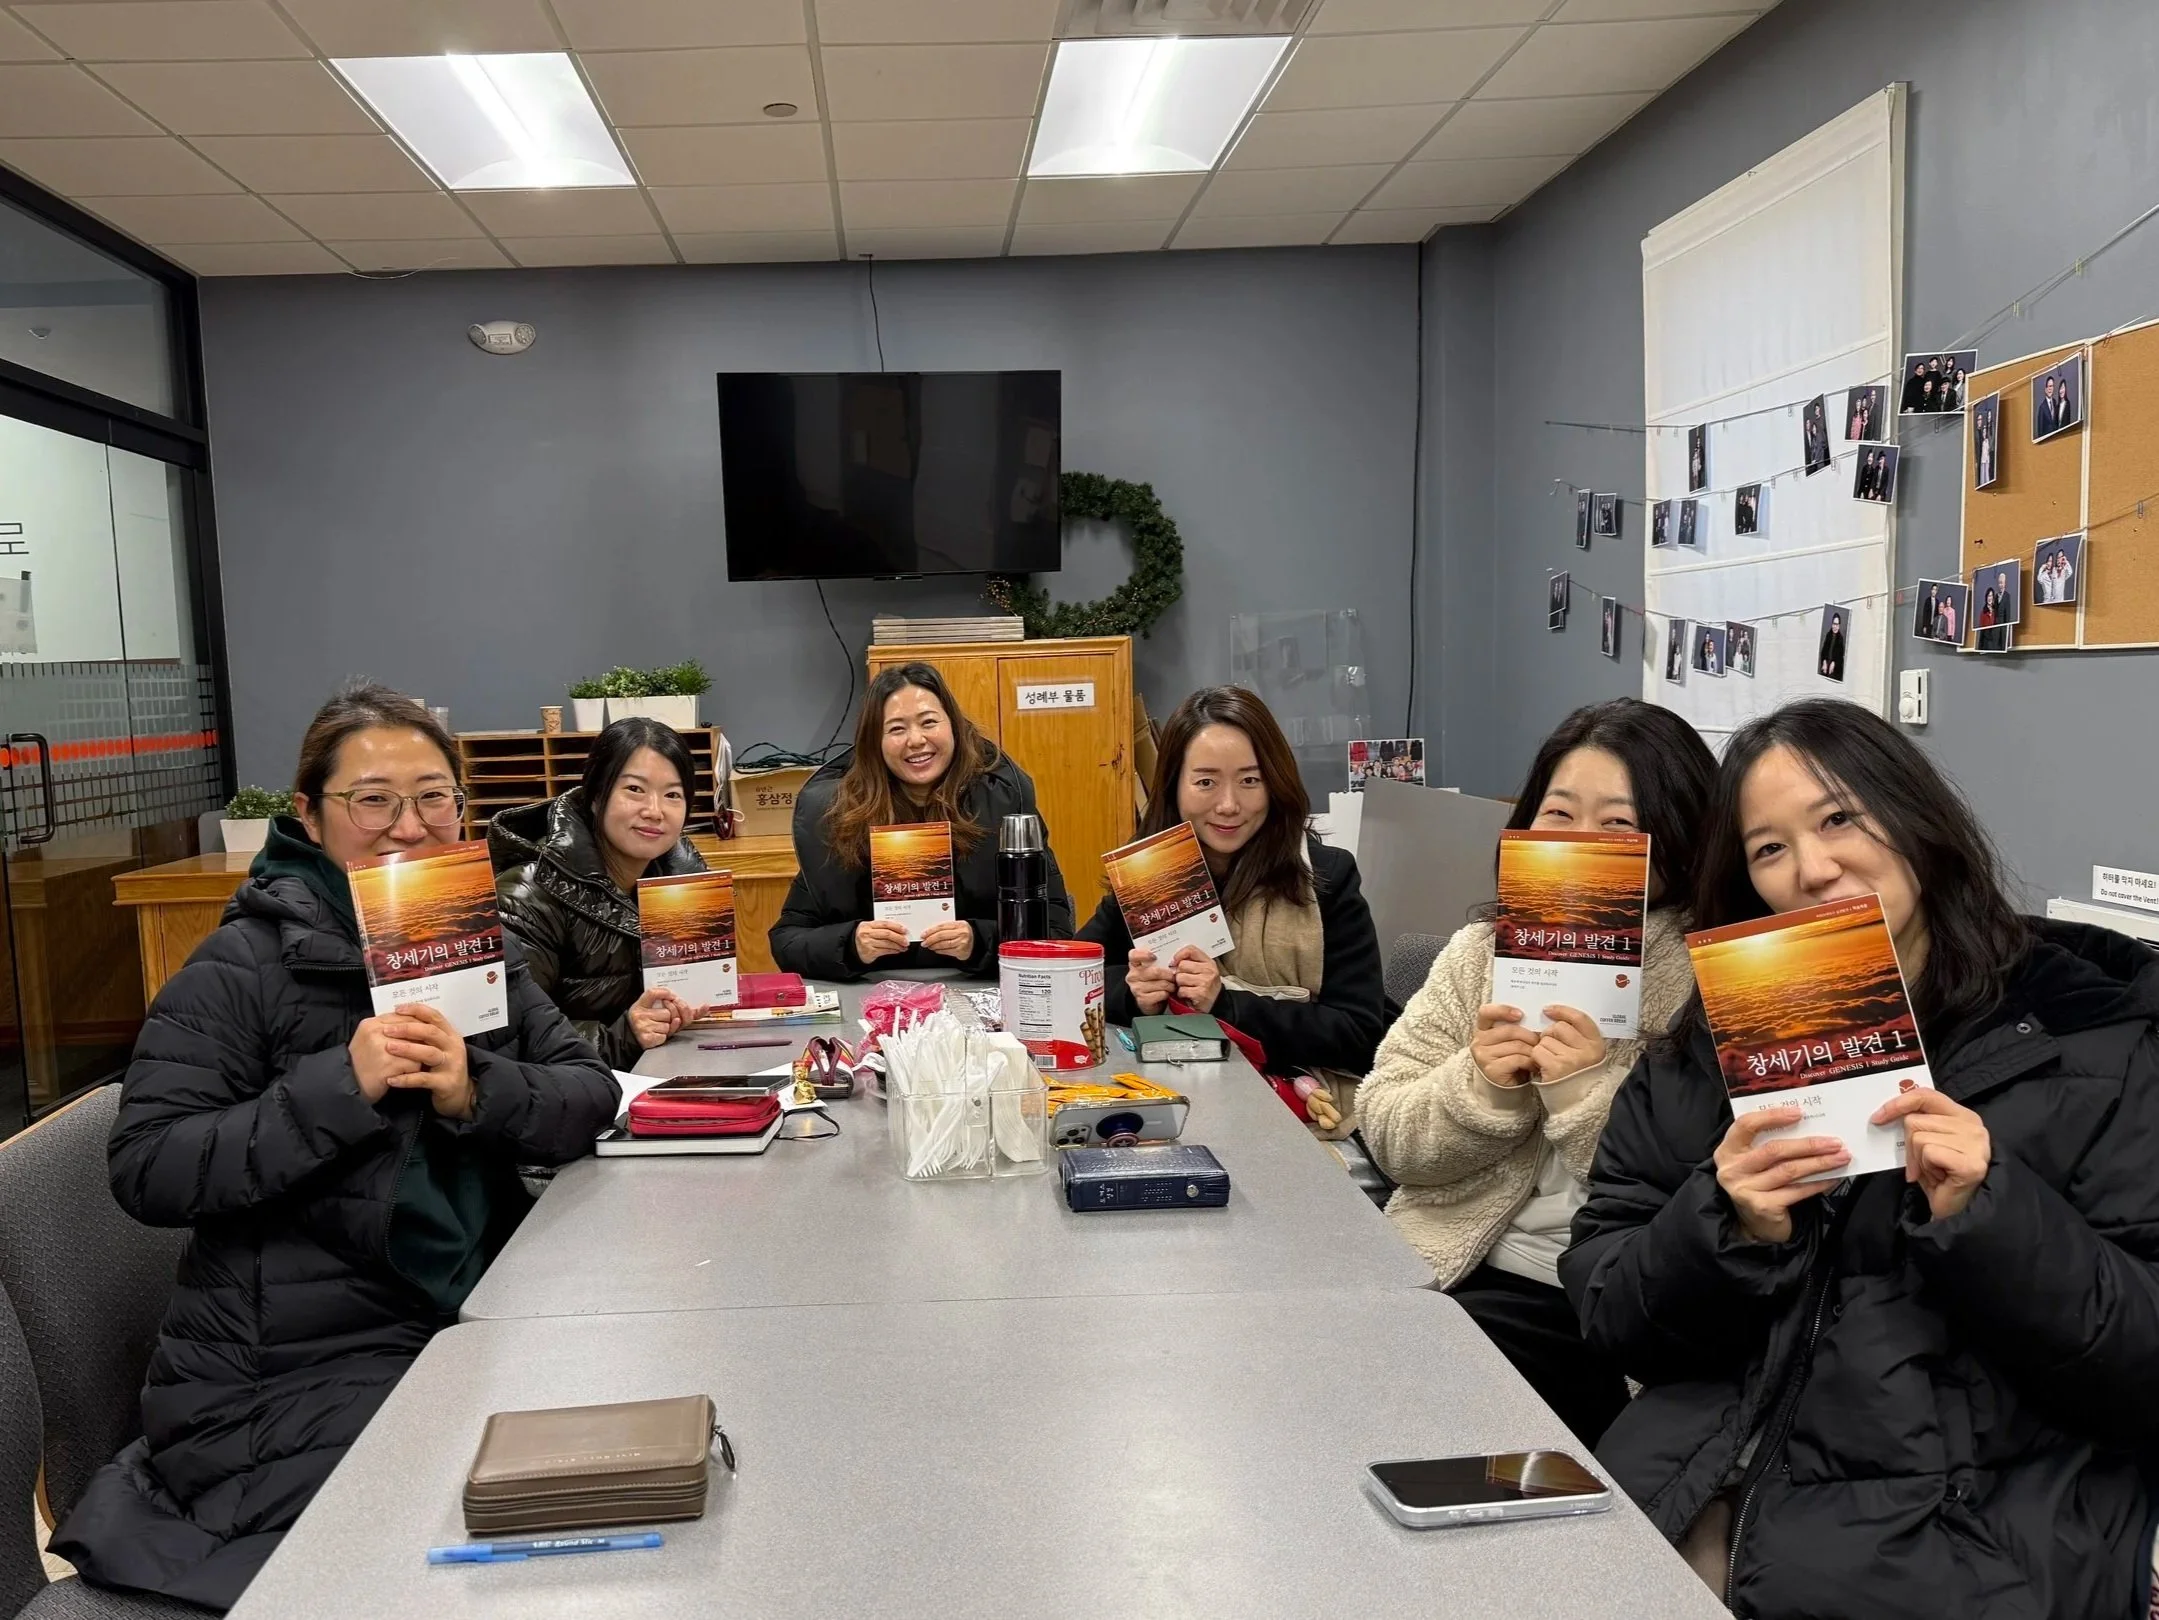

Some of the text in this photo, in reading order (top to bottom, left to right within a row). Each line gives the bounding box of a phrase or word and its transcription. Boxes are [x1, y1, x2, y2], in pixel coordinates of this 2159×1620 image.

[1025, 689, 1086, 705] 성례부 물품
[756, 792, 792, 806] 홍삼정
[884, 880, 948, 894] 창세기의 발견 1
[2102, 872, 2157, 889] 히터를 막지 마세요!
[2100, 888, 2108, 896] Do
[2118, 892, 2132, 900] cover
[2132, 895, 2142, 903] the
[2142, 895, 2159, 905] Vent!
[1140, 901, 1181, 925] 창세기의
[1182, 891, 1202, 908] 발견
[1204, 889, 1210, 899] 1
[1514, 928, 1631, 951] 창세기의 발견 1
[386, 936, 495, 970] 창세기의 발견 1
[655, 942, 698, 958] 창세기의
[701, 939, 721, 952] 발견
[724, 939, 730, 949] 1
[1512, 966, 1559, 977] 모든 것의 시작
[1746, 1030, 1906, 1076] 창세기의 발견 1
[1800, 1070, 1826, 1080] Discover
[1829, 1063, 1864, 1075] GENESIS
[1871, 1058, 1889, 1068] Study
[1890, 1054, 1909, 1063] Guide
[1803, 1095, 1822, 1107] 시작
